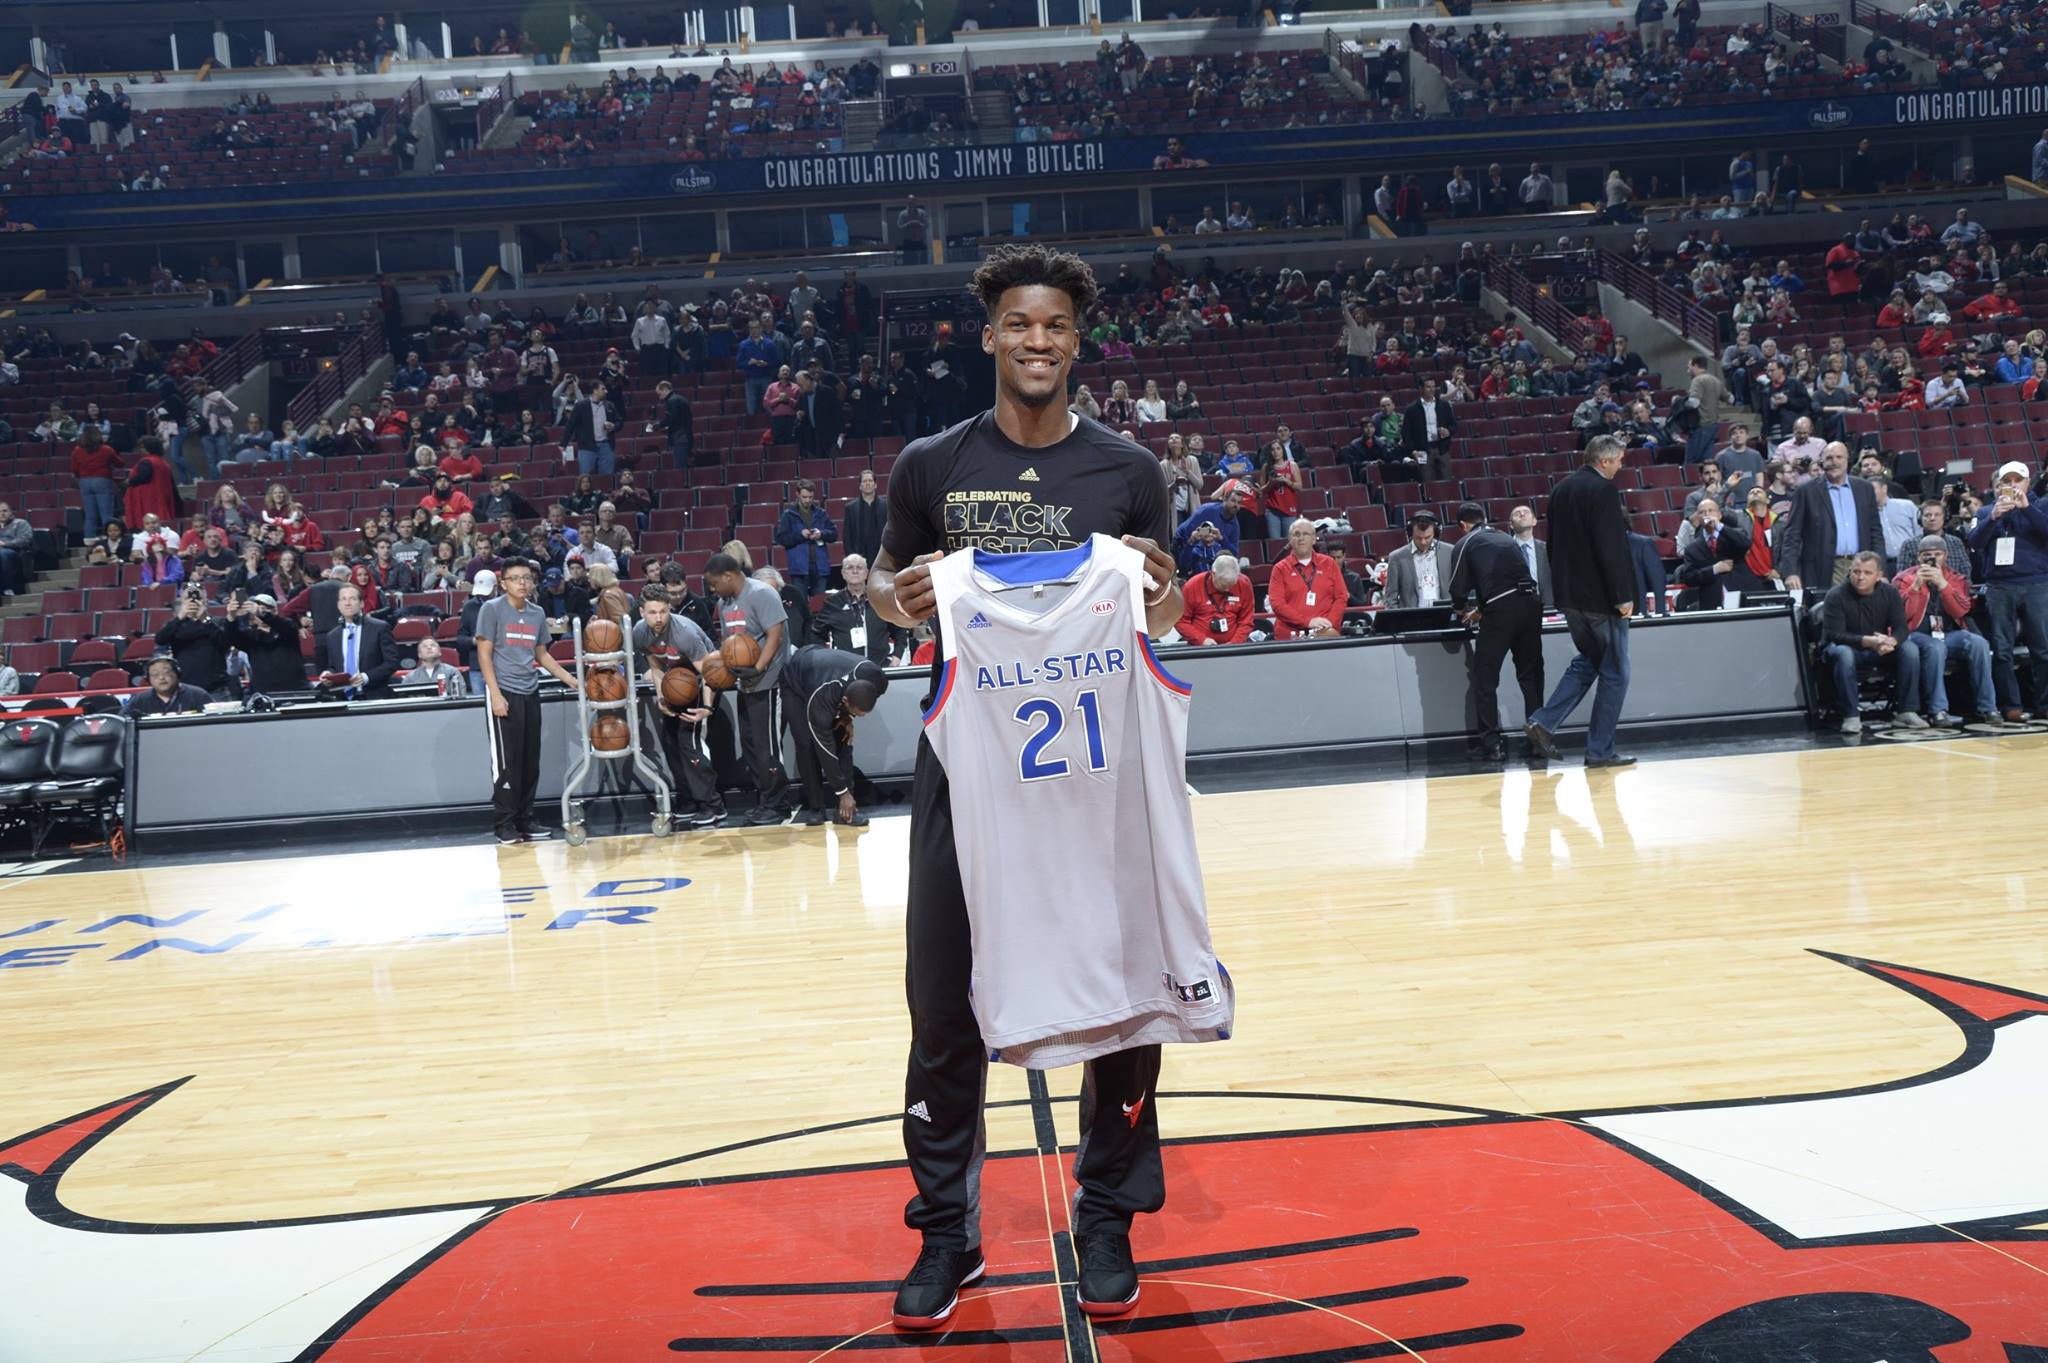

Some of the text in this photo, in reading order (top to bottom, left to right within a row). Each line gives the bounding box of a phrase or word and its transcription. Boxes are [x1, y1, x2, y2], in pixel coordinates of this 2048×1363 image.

[934, 62, 955, 74] 201
[1896, 85, 2048, 123] CONGRATULATIO
[764, 142, 1105, 188] CONGRATULATIONS JIMMY BUTLER!
[905, 322, 928, 337] 122
[946, 490, 1032, 503] CELEBRATING
[944, 502, 1073, 537] BLACK
[1013, 688, 1109, 783] 21
